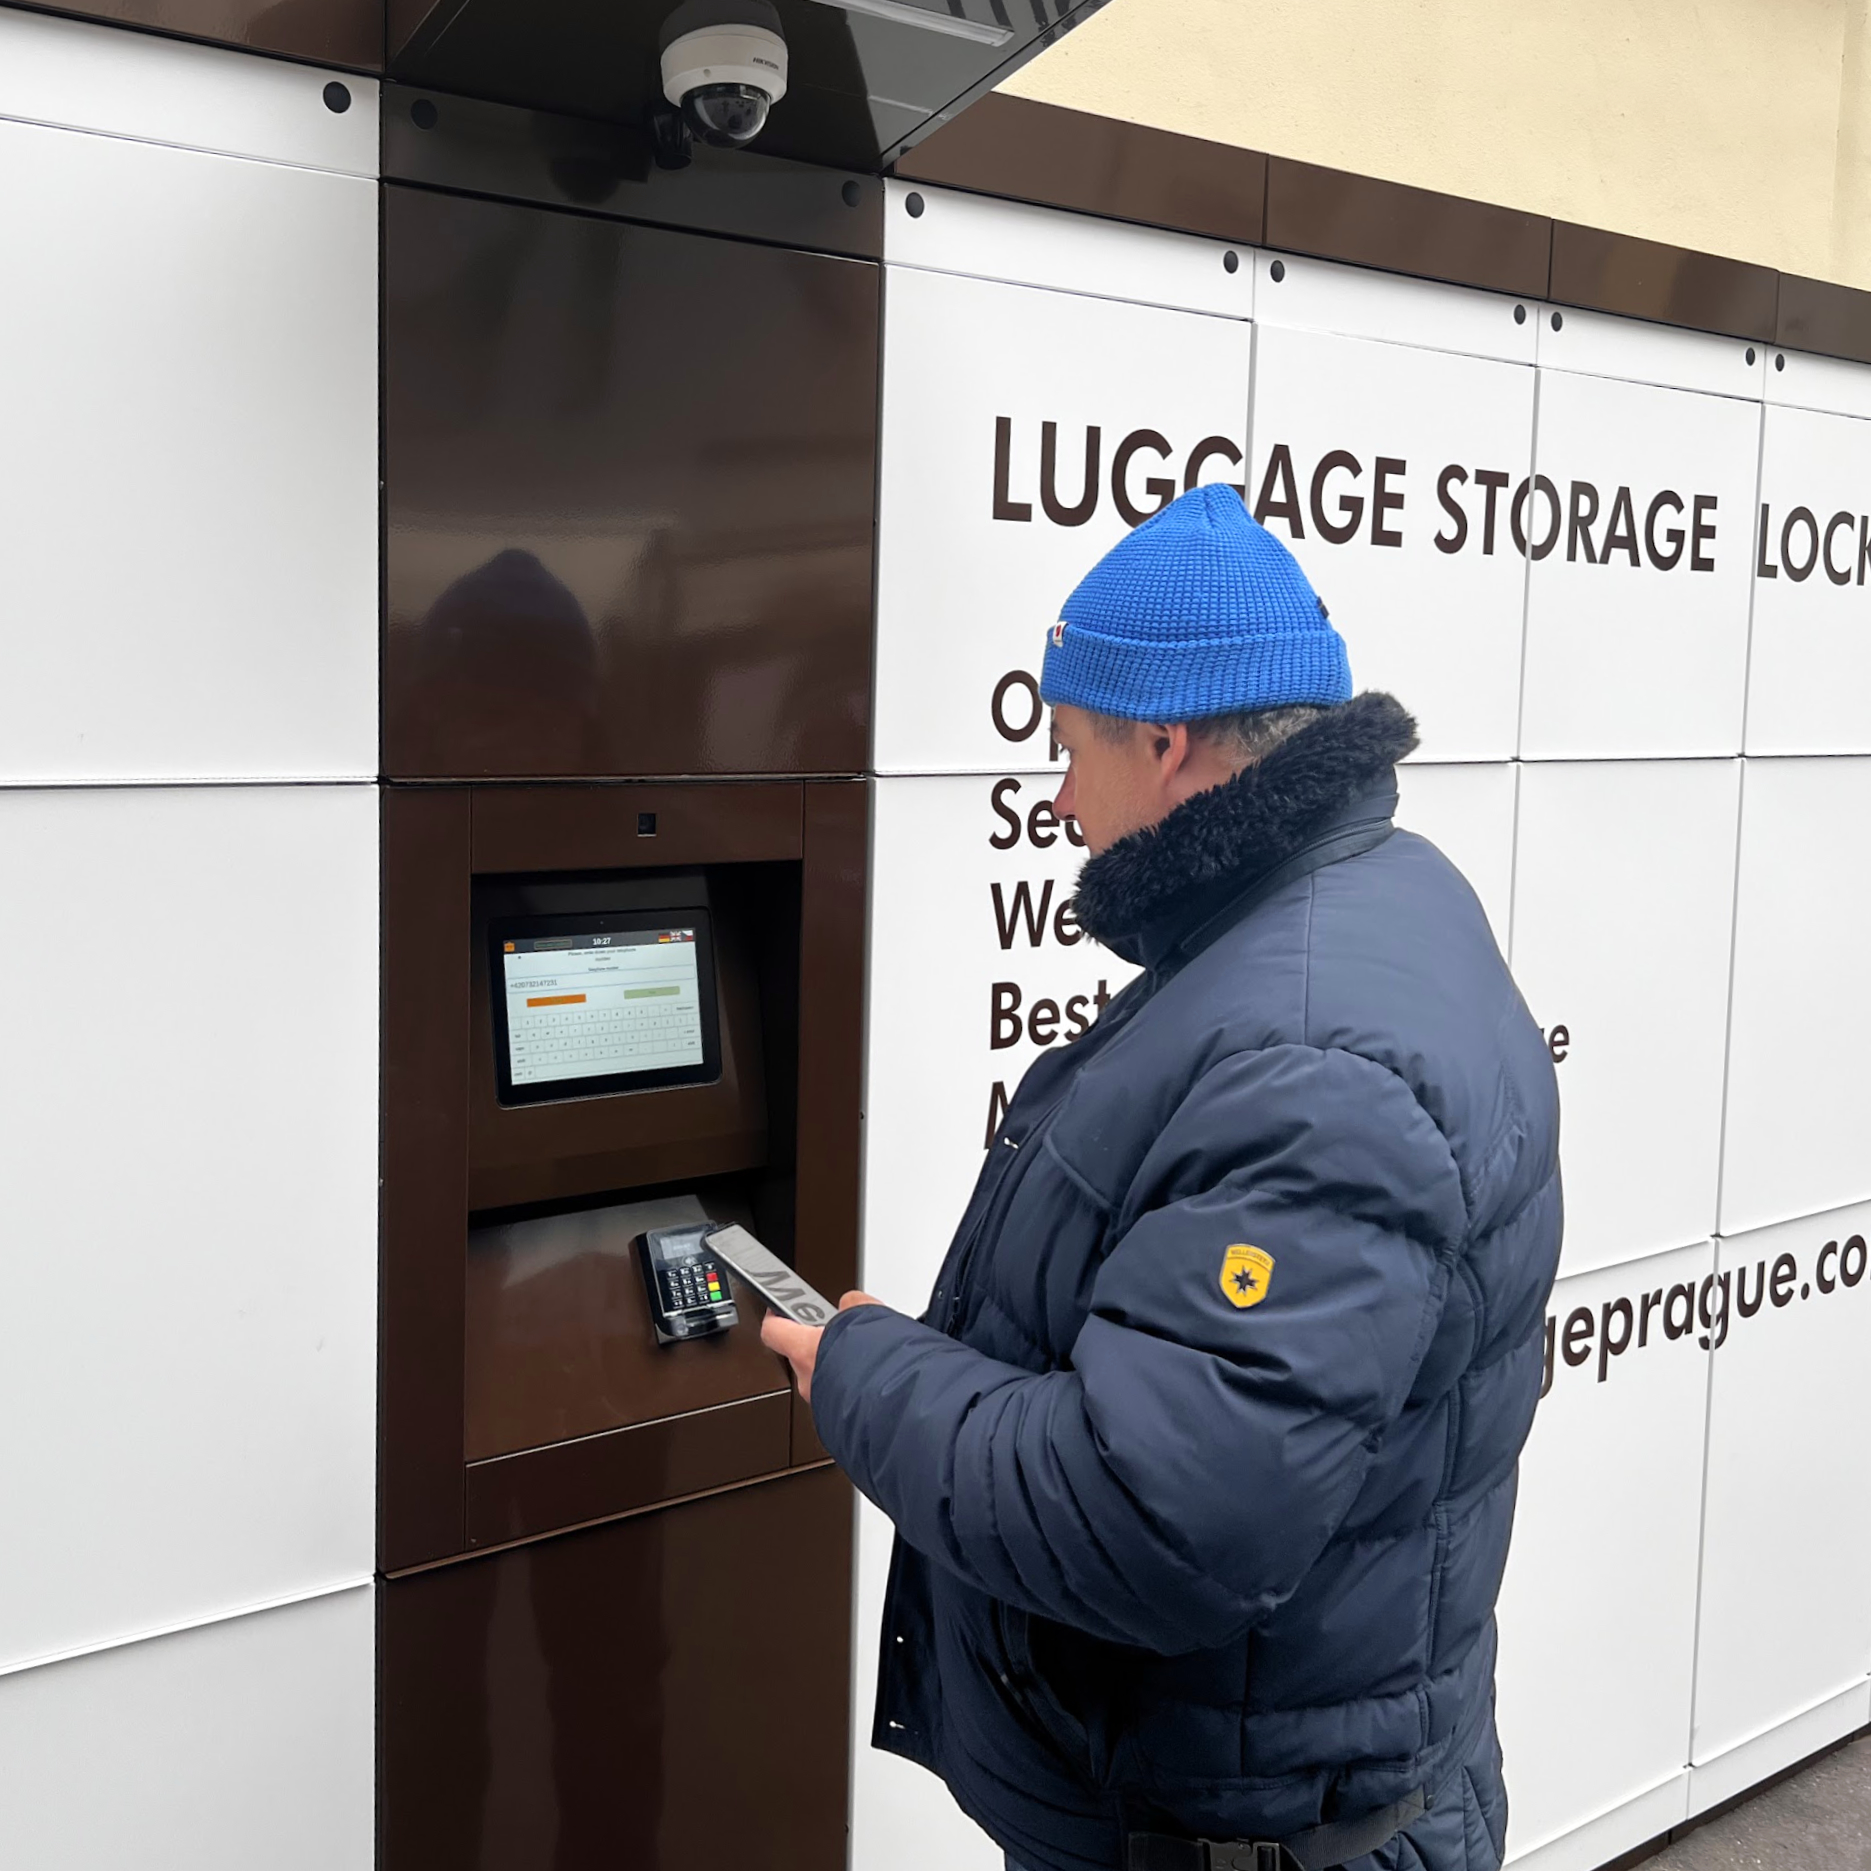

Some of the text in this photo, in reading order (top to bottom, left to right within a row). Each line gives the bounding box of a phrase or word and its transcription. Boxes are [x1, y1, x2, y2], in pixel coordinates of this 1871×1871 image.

[992, 416, 1407, 547] LUGGAGE
[1433, 464, 1718, 572] STORAGE
[592, 937, 611, 946] 10:27
[990, 879, 1081, 950] We
